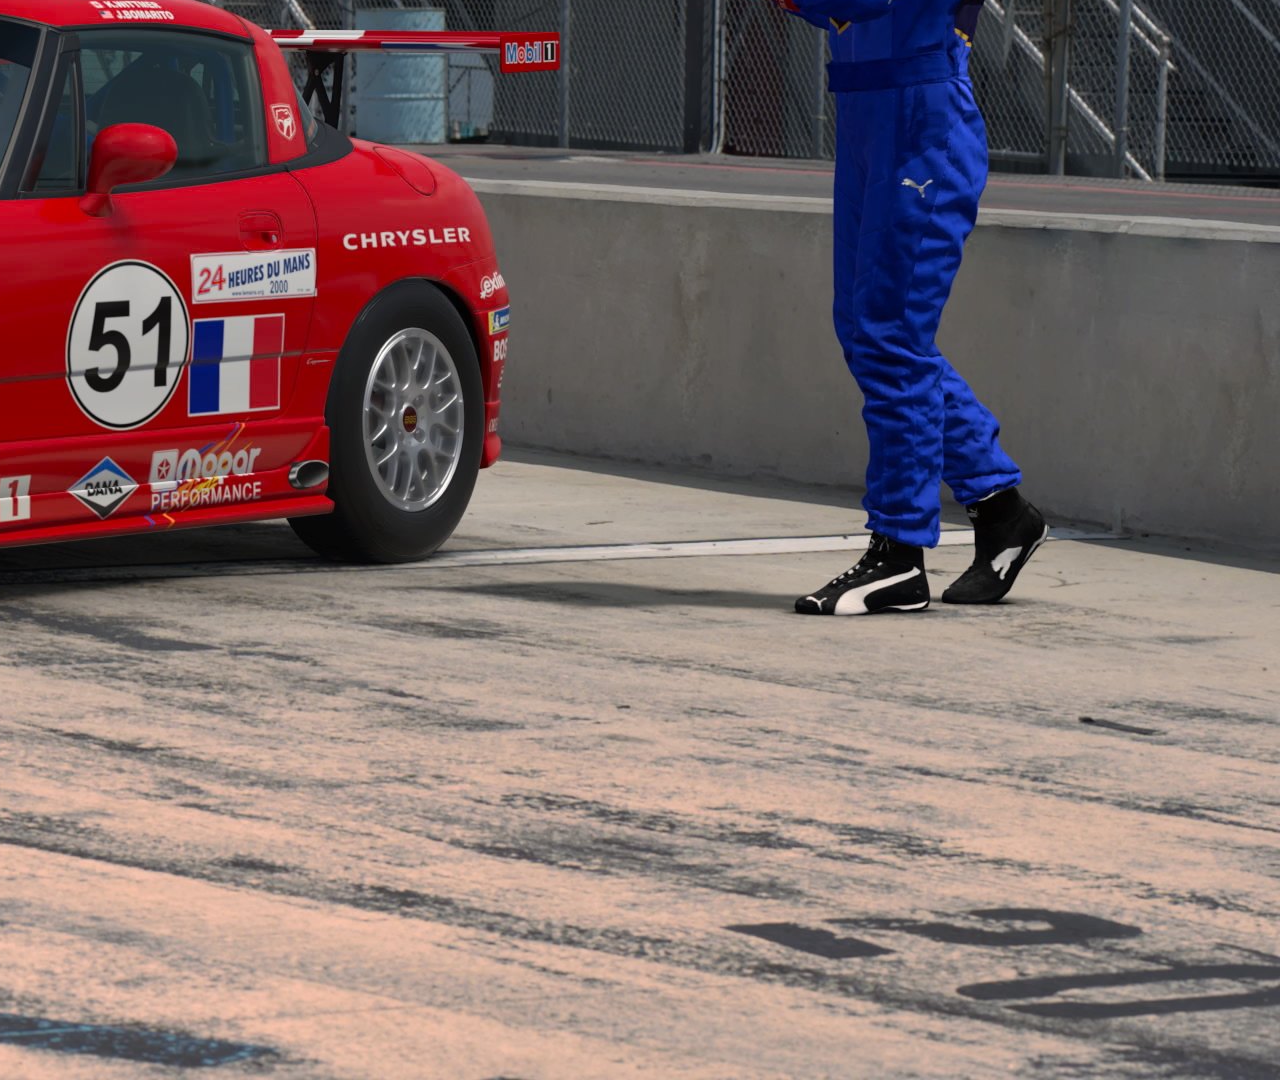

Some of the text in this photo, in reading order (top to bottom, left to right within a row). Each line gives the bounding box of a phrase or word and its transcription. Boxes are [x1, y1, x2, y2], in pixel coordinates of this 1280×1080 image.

[116, 10, 175, 20] J.BOMARITO
[505, 41, 542, 64] Mobil
[342, 227, 471, 250] CHRYSLER
[197, 253, 310, 295] 24 HEURES DU MANS
[270, 280, 288, 294] 2000
[84, 296, 172, 392] 51
[176, 448, 262, 484] Mopar
[85, 480, 123, 497] DANA
[151, 481, 262, 511] PERFORMANCE
